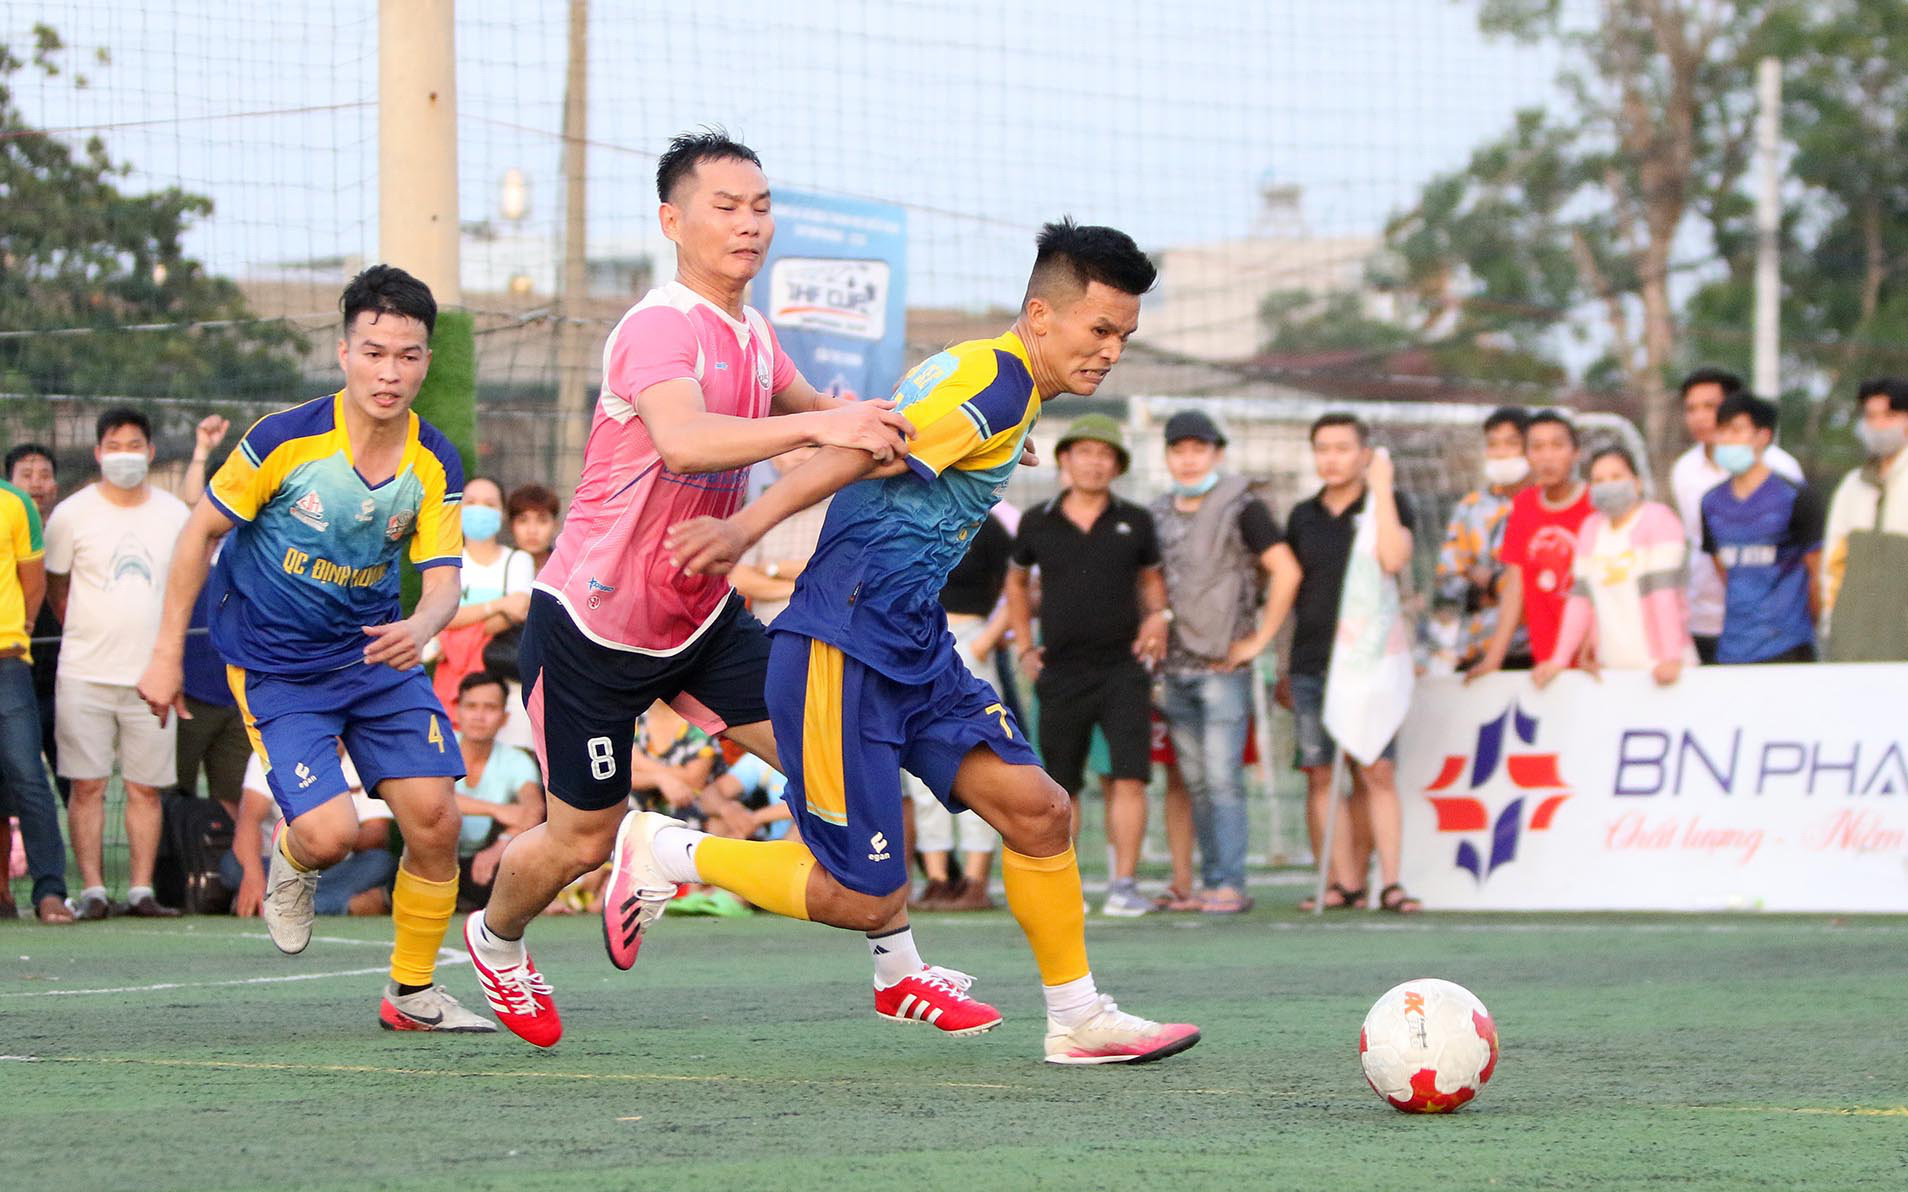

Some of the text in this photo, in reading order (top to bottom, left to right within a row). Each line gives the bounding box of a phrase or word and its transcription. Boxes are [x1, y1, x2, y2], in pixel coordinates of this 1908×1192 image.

[283, 547, 309, 575] QC
[428, 714, 446, 753] 4
[984, 703, 1014, 740] 7
[587, 736, 616, 780] 8
[1612, 726, 1743, 796] BN
[868, 852, 891, 862] egan
